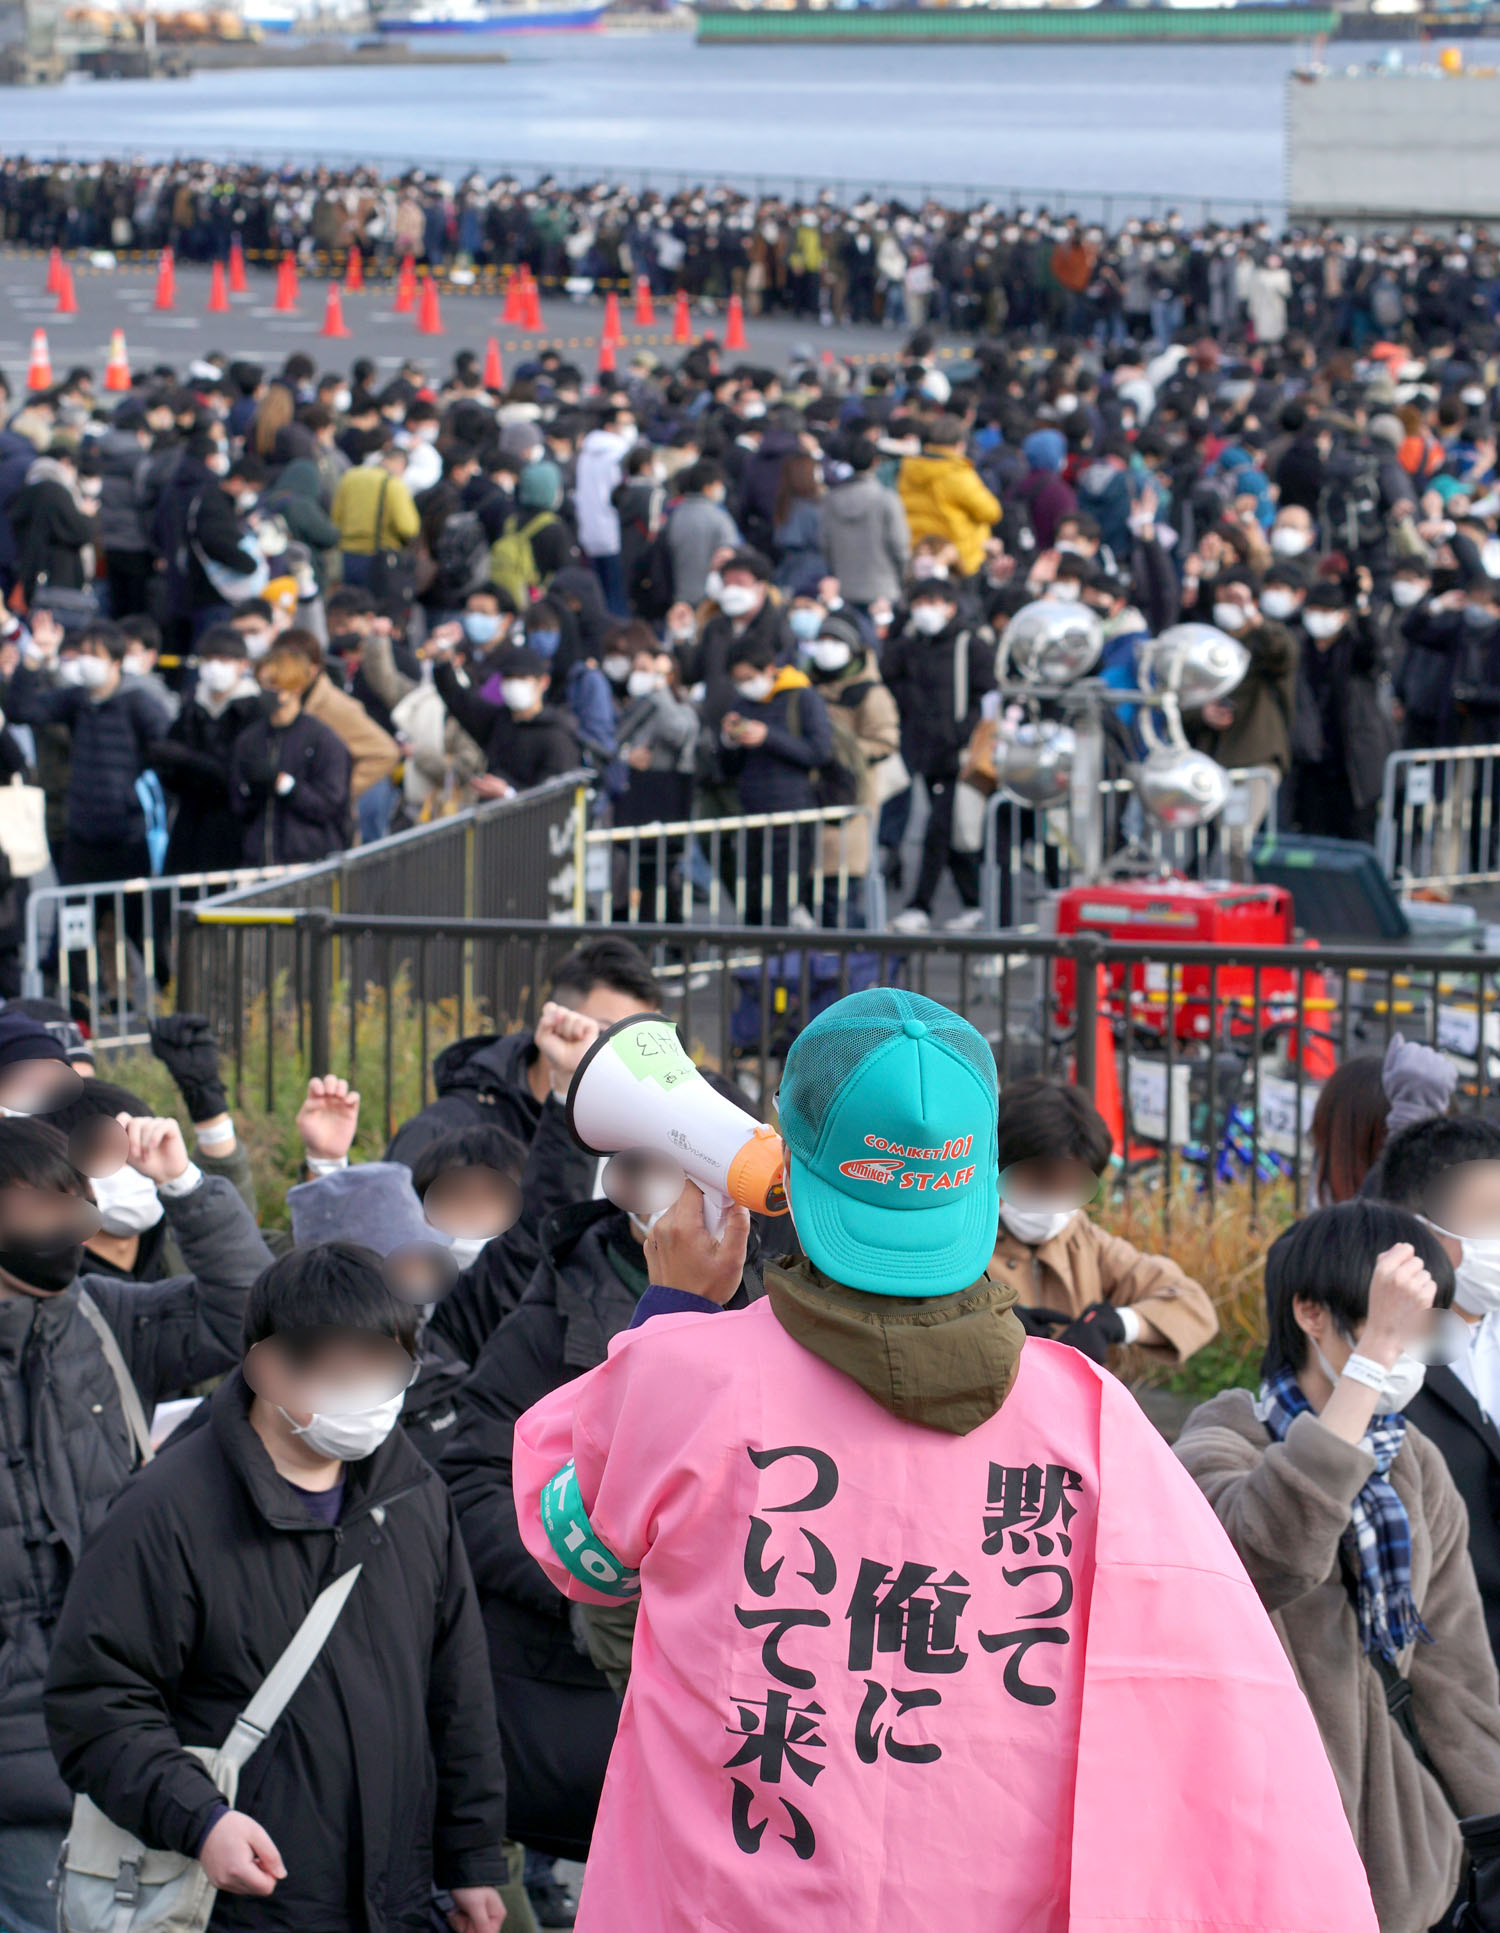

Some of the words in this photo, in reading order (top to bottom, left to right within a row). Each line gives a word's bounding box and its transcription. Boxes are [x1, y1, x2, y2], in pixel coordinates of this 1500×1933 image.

[900, 1164, 976, 1191] STAFF
[722, 1446, 839, 1861] ついて来い
[845, 1557, 972, 1764] 俺に
[977, 1461, 1084, 1707] 黙って
